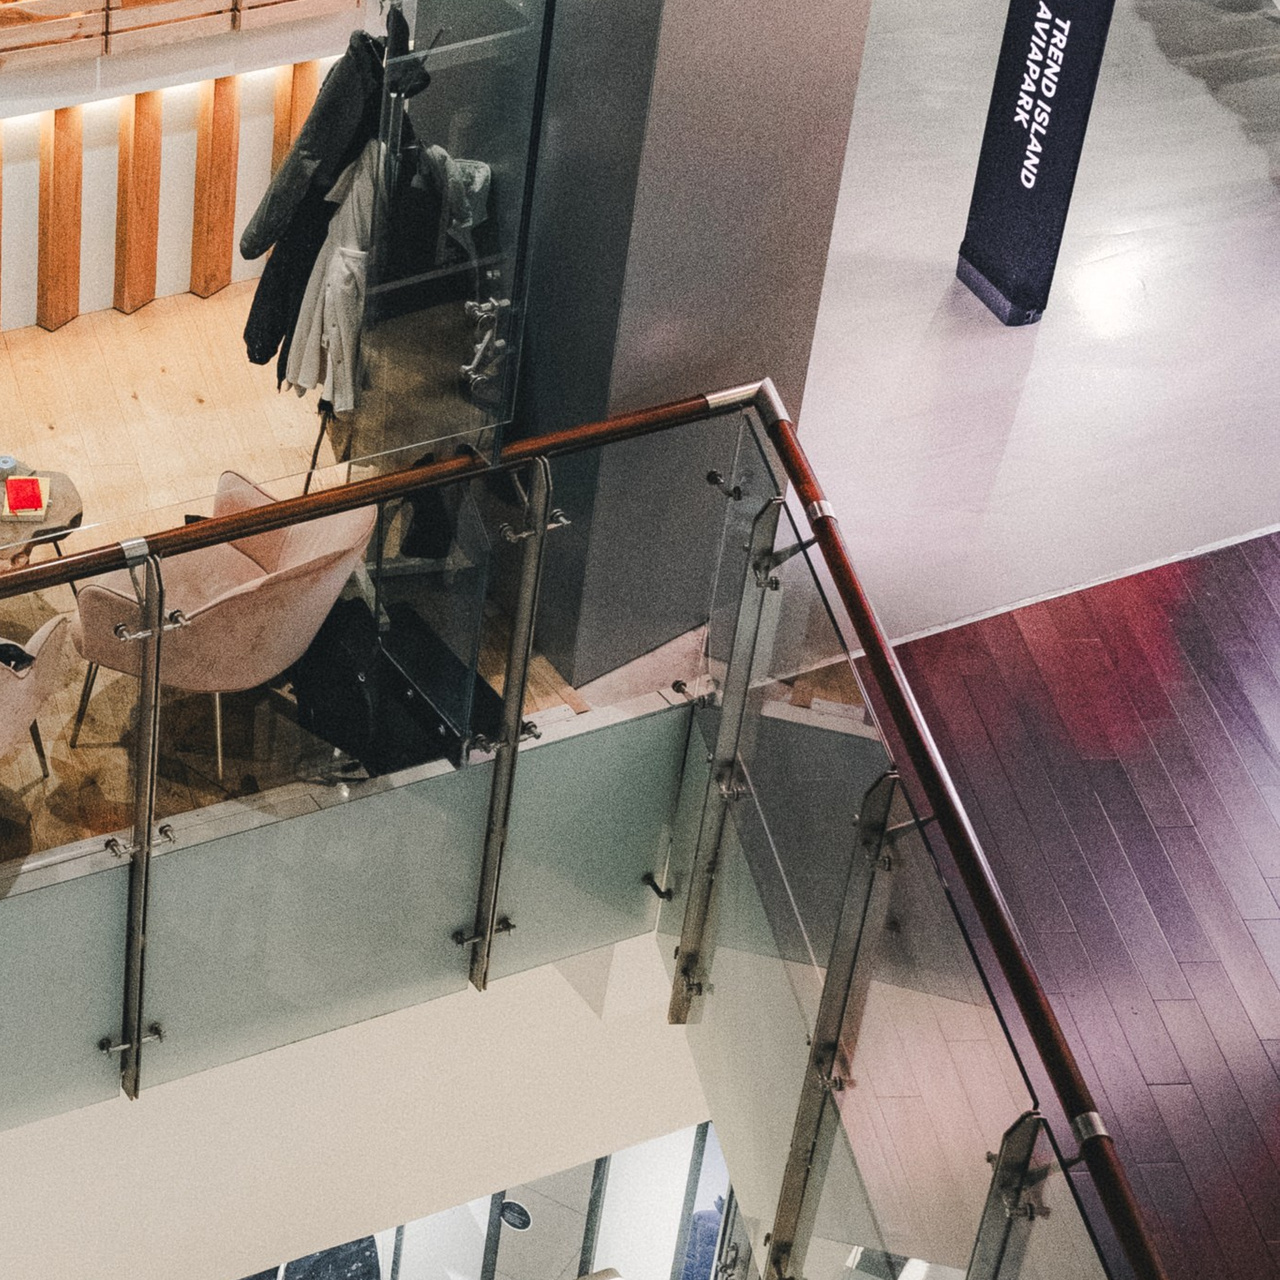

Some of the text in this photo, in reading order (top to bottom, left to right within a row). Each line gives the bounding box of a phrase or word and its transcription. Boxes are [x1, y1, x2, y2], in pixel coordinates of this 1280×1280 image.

[1012, 0, 1053, 129] AVIAPARK
[1020, 16, 1071, 190] TREND ISLAND
